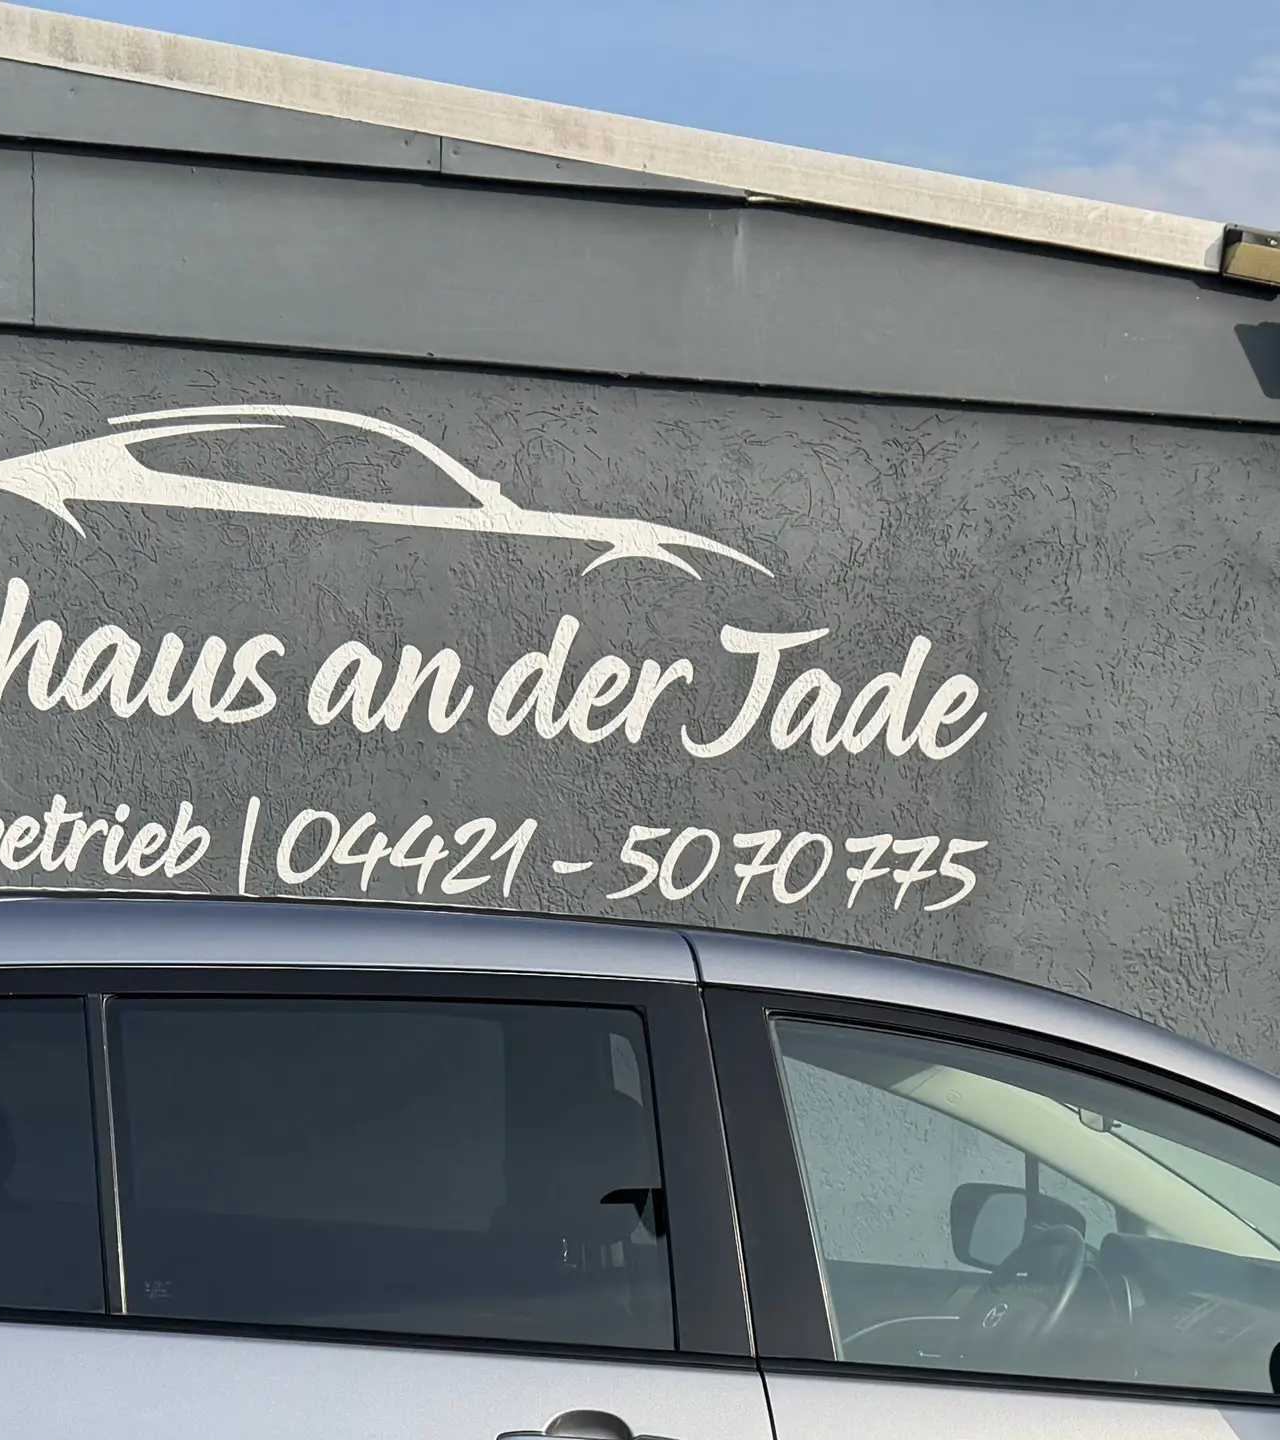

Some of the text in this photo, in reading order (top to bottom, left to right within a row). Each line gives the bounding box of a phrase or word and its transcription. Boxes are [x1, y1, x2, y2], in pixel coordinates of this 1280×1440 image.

[306, 639, 475, 735] an
[486, 613, 695, 745] der
[679, 623, 989, 761] Jade
[275, 807, 539, 899] 04421
